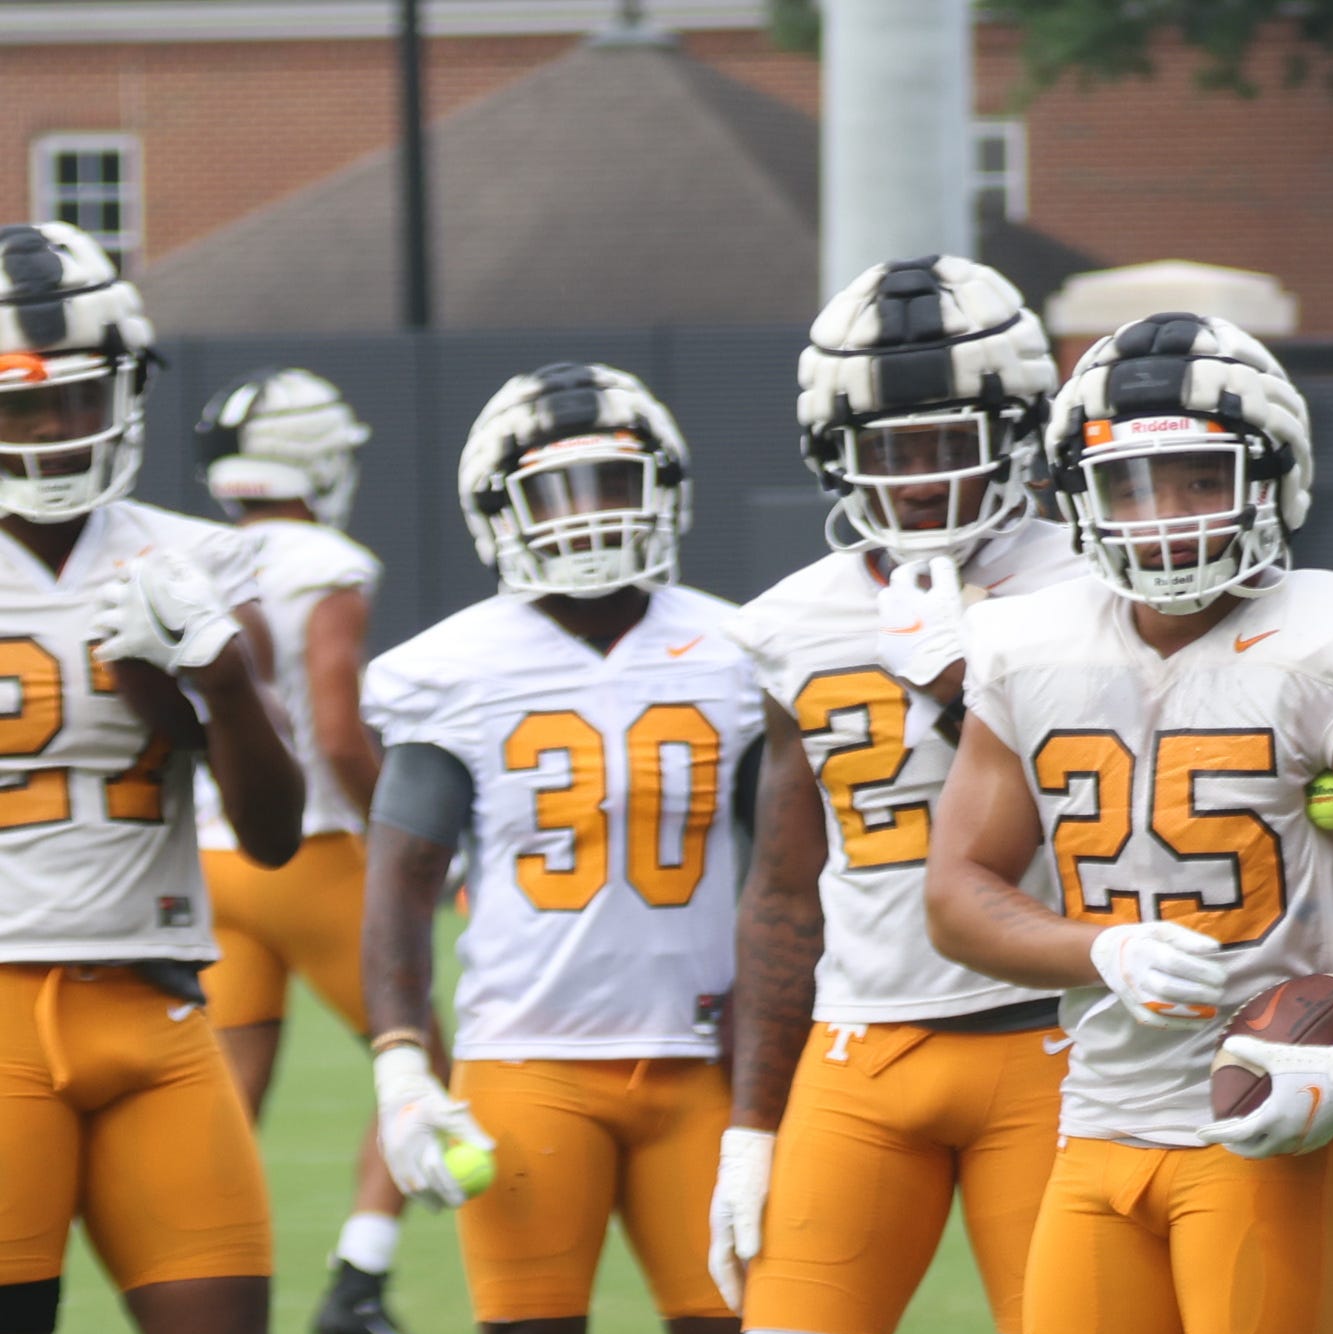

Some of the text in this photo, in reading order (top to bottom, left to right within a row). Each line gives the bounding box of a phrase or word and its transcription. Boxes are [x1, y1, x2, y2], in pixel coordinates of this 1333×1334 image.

[1131, 418, 1190, 432] Riddell
[1154, 575, 1194, 585] Ridell
[500, 703, 720, 913] 30
[1031, 727, 1287, 950] 25
[822, 1022, 870, 1067] T
